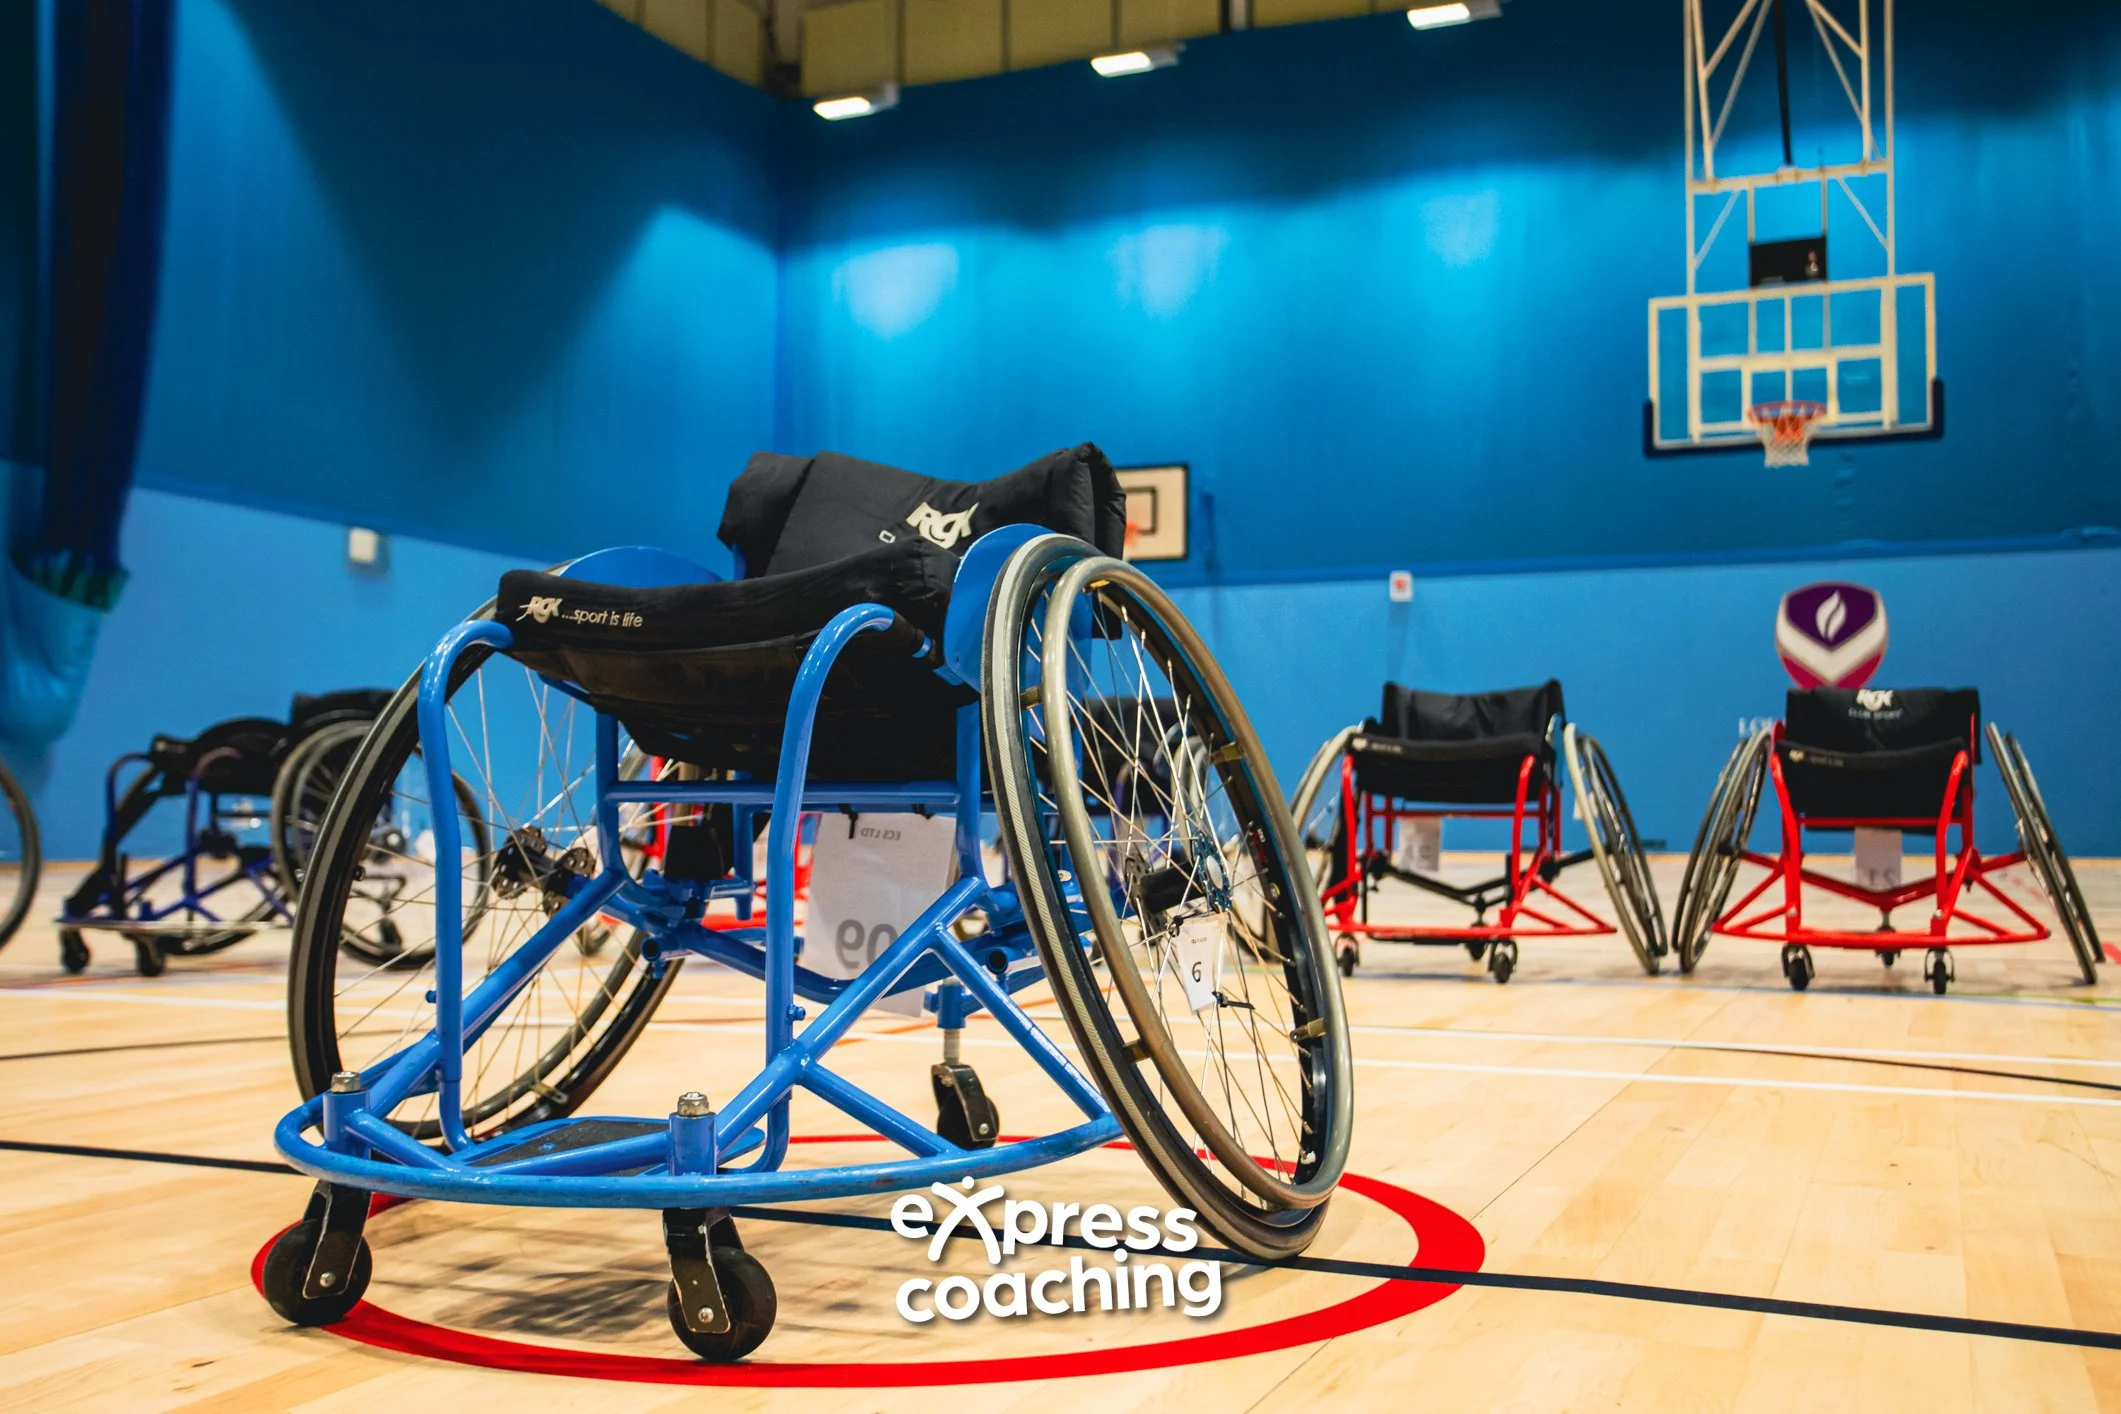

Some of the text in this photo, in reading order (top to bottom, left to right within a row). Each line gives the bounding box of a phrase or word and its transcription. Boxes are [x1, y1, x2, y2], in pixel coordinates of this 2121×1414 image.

[610, 611, 621, 626] is
[622, 612, 644, 628] life
[1191, 961, 1202, 983] 6
